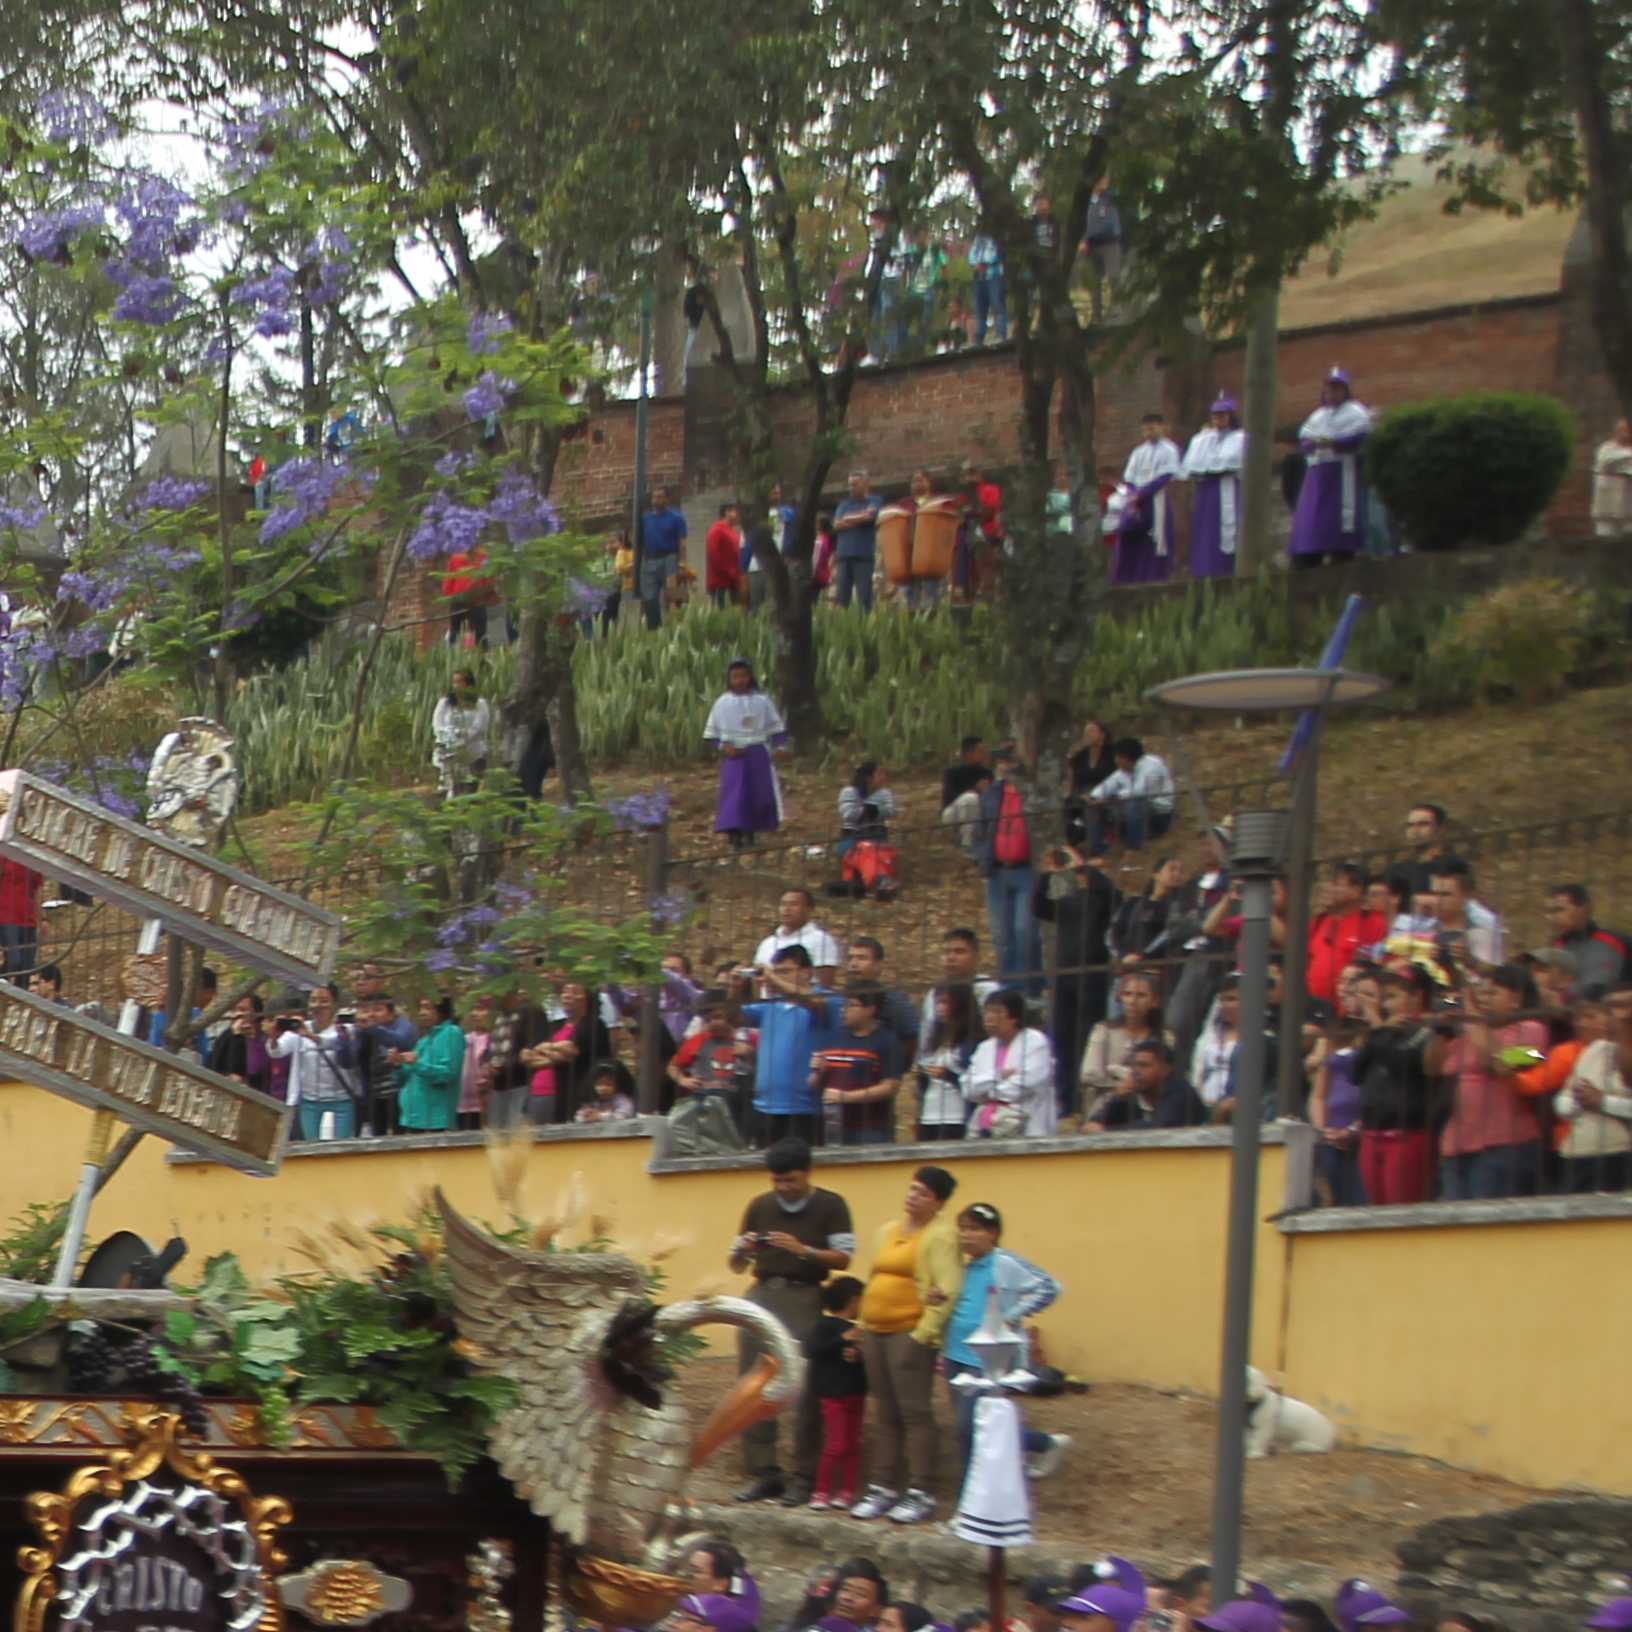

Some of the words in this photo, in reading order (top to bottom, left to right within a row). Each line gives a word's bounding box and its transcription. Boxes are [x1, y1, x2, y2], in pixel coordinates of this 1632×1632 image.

[16, 790, 100, 864] SANGRE
[101, 832, 135, 879] DE
[141, 846, 214, 914] CRISTO
[65, 1031, 97, 1081] LA
[108, 1046, 157, 1105] VIDA
[98, 1556, 204, 1615] CRISTO
